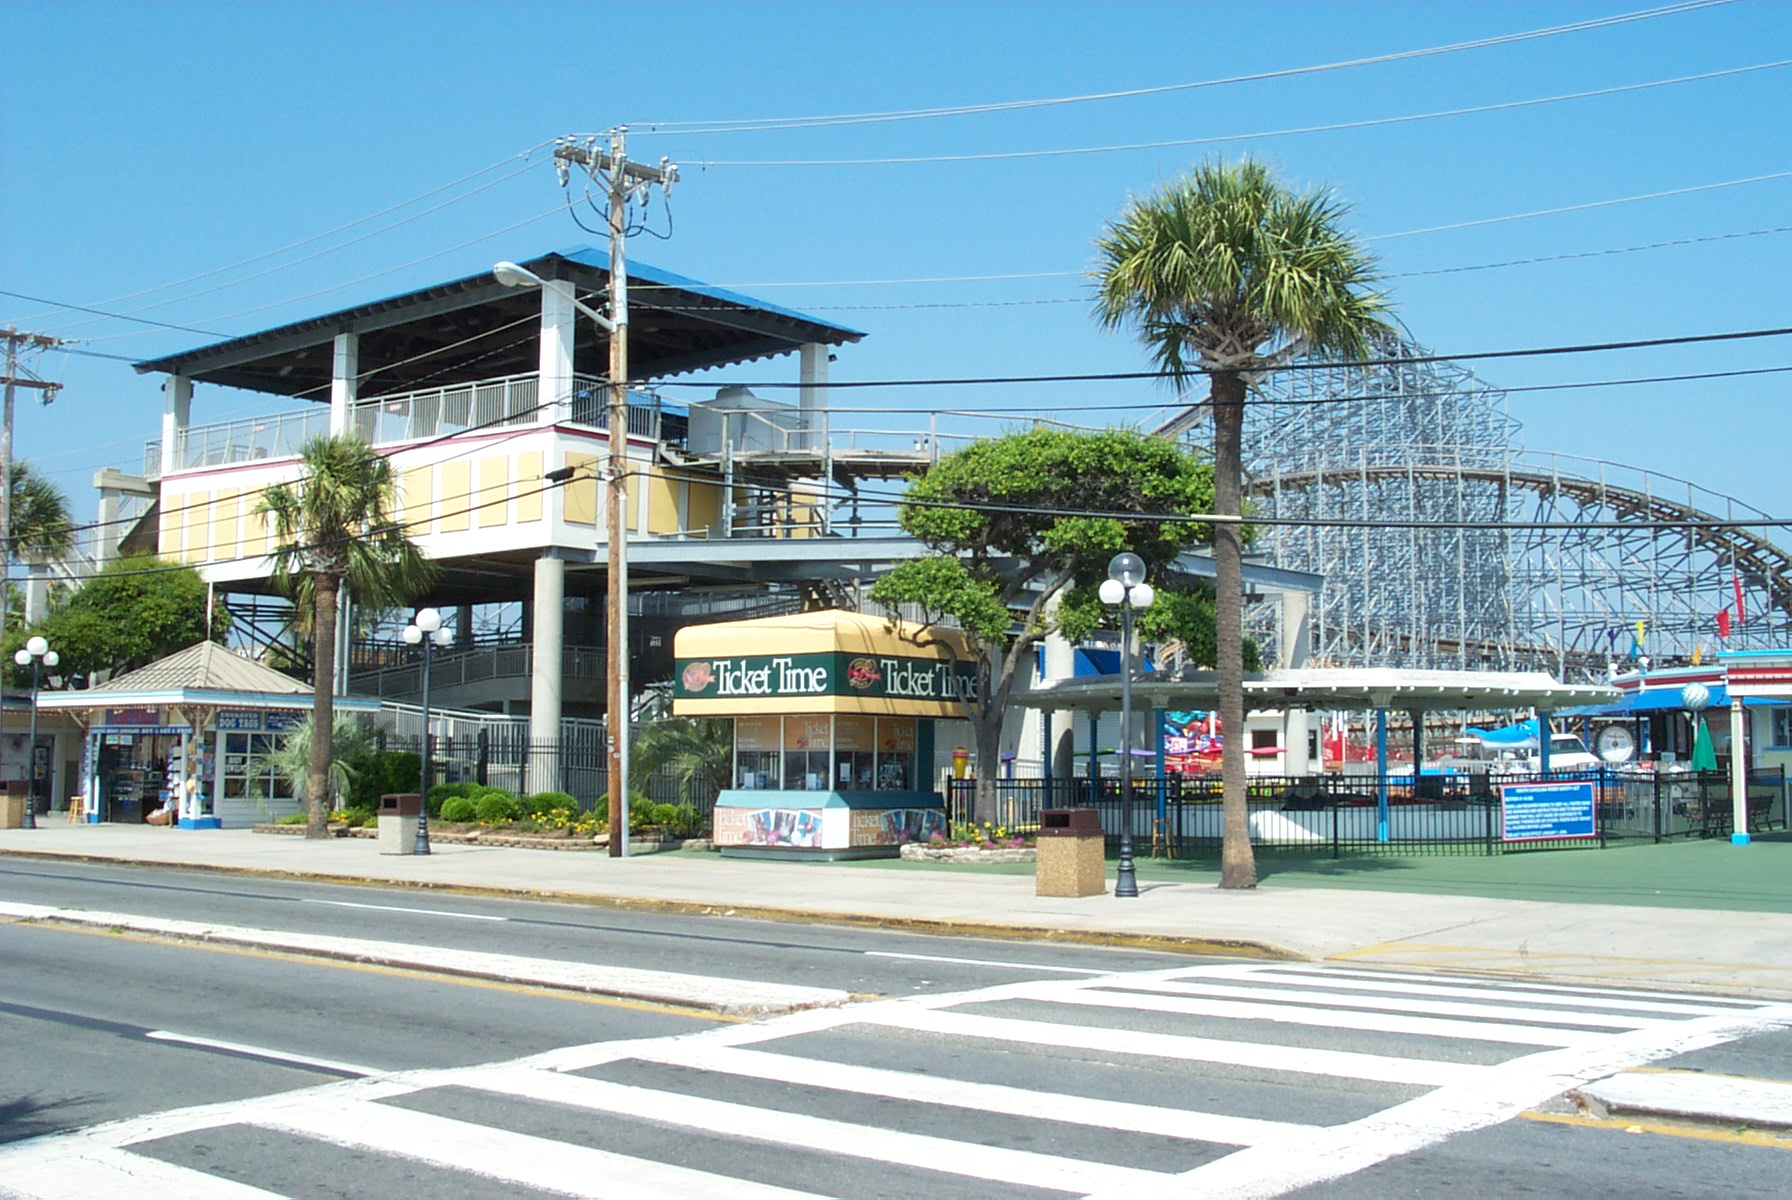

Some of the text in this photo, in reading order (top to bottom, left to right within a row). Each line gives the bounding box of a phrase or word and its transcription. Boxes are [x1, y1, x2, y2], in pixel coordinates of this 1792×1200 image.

[713, 659, 772, 695] Ticket
[773, 657, 827, 693] Time
[881, 659, 936, 696] Ticket
[220, 719, 237, 728] DOG
[238, 719, 259, 728] TAGS
[716, 809, 747, 827] Ticket
[850, 810, 880, 828] Ticket
